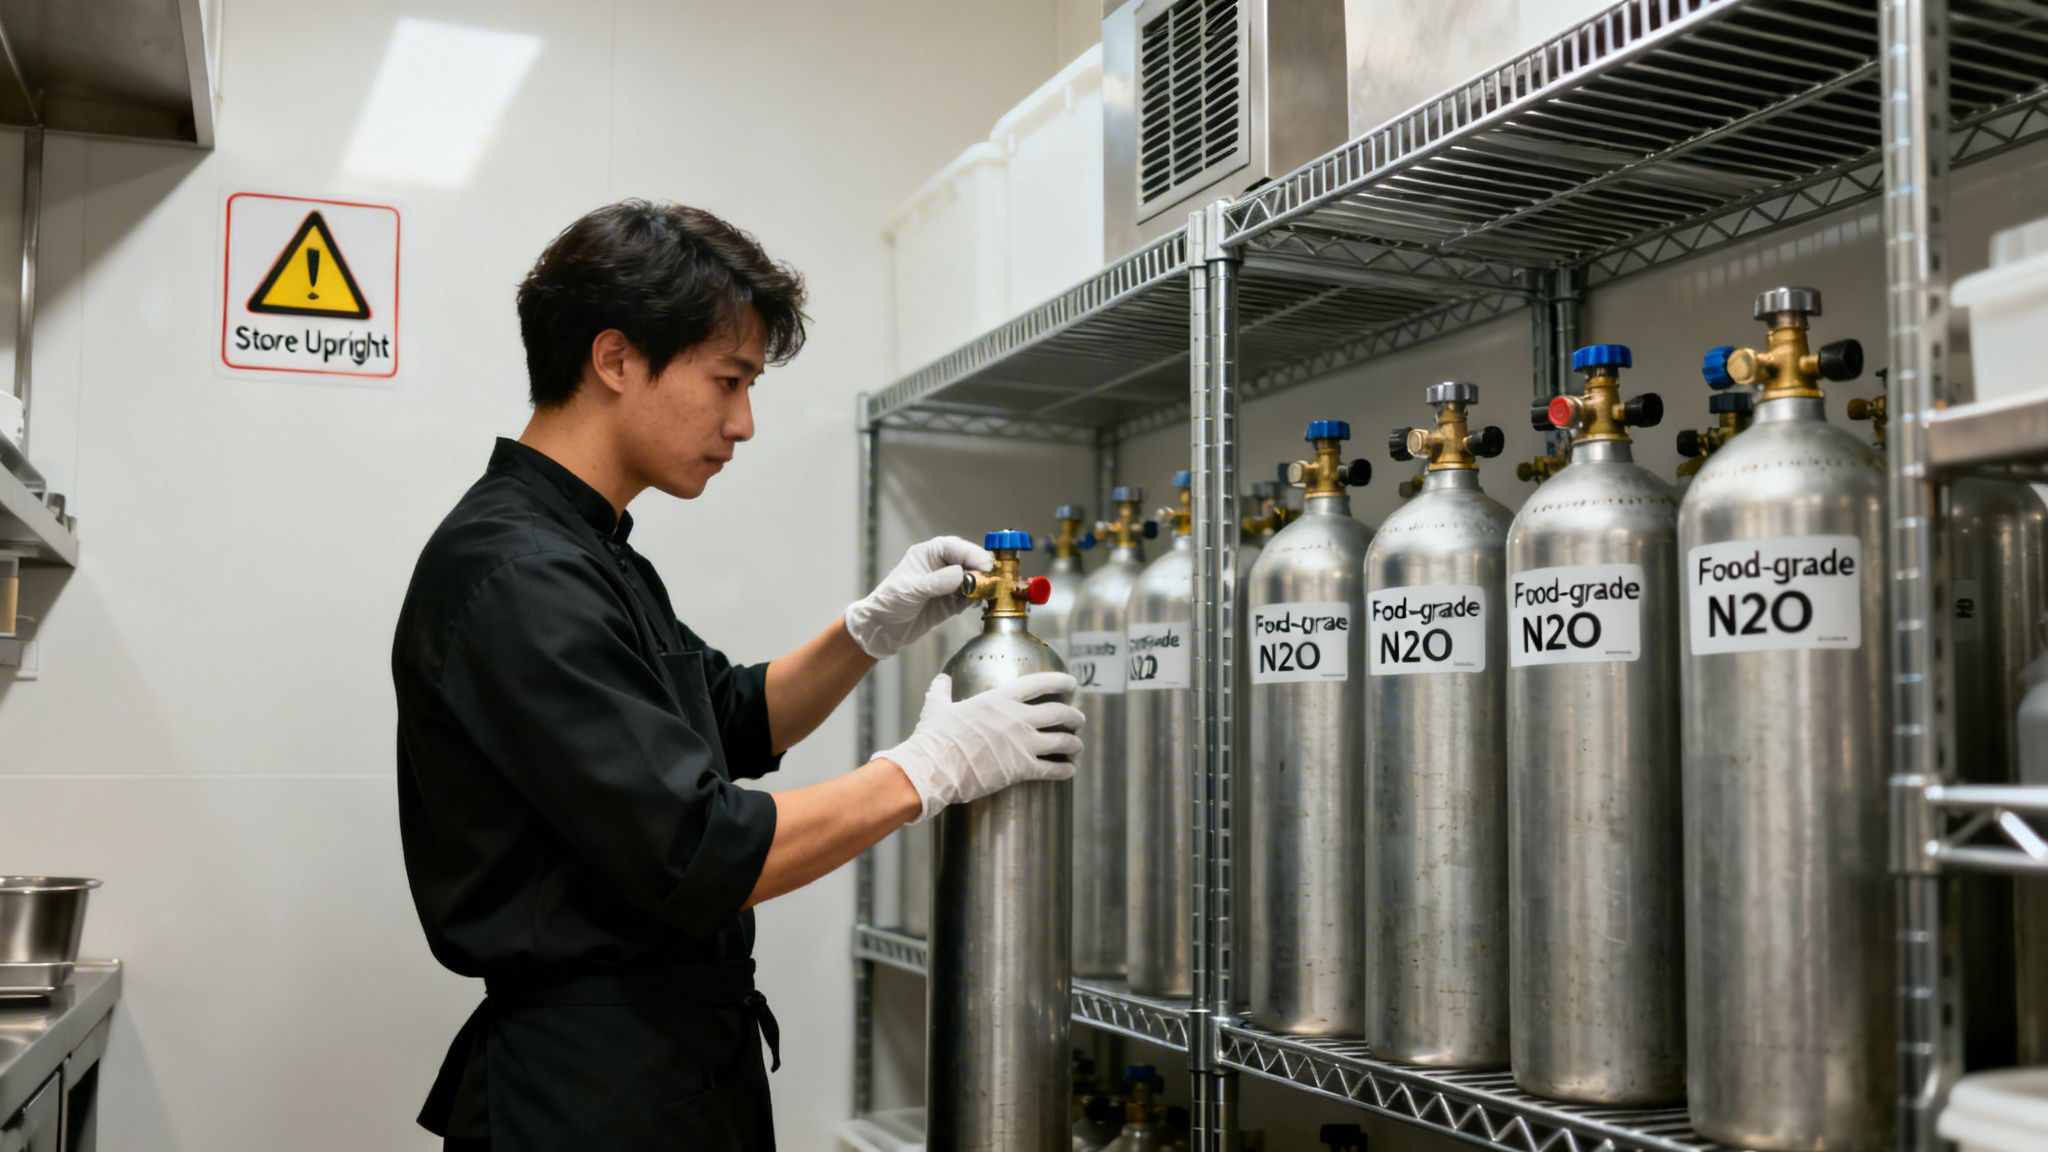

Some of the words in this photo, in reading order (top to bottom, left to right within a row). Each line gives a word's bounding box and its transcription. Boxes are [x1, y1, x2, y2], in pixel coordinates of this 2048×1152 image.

[235, 325, 298, 353] Store
[305, 328, 390, 366] Upright
[1699, 547, 1854, 586] Food-grade
[1515, 575, 1640, 608] Food-grade
[1522, 611, 1602, 654] N2O
[1708, 590, 1813, 638] N2O
[1260, 641, 1321, 674] N2O
[1381, 628, 1453, 665] N2O
